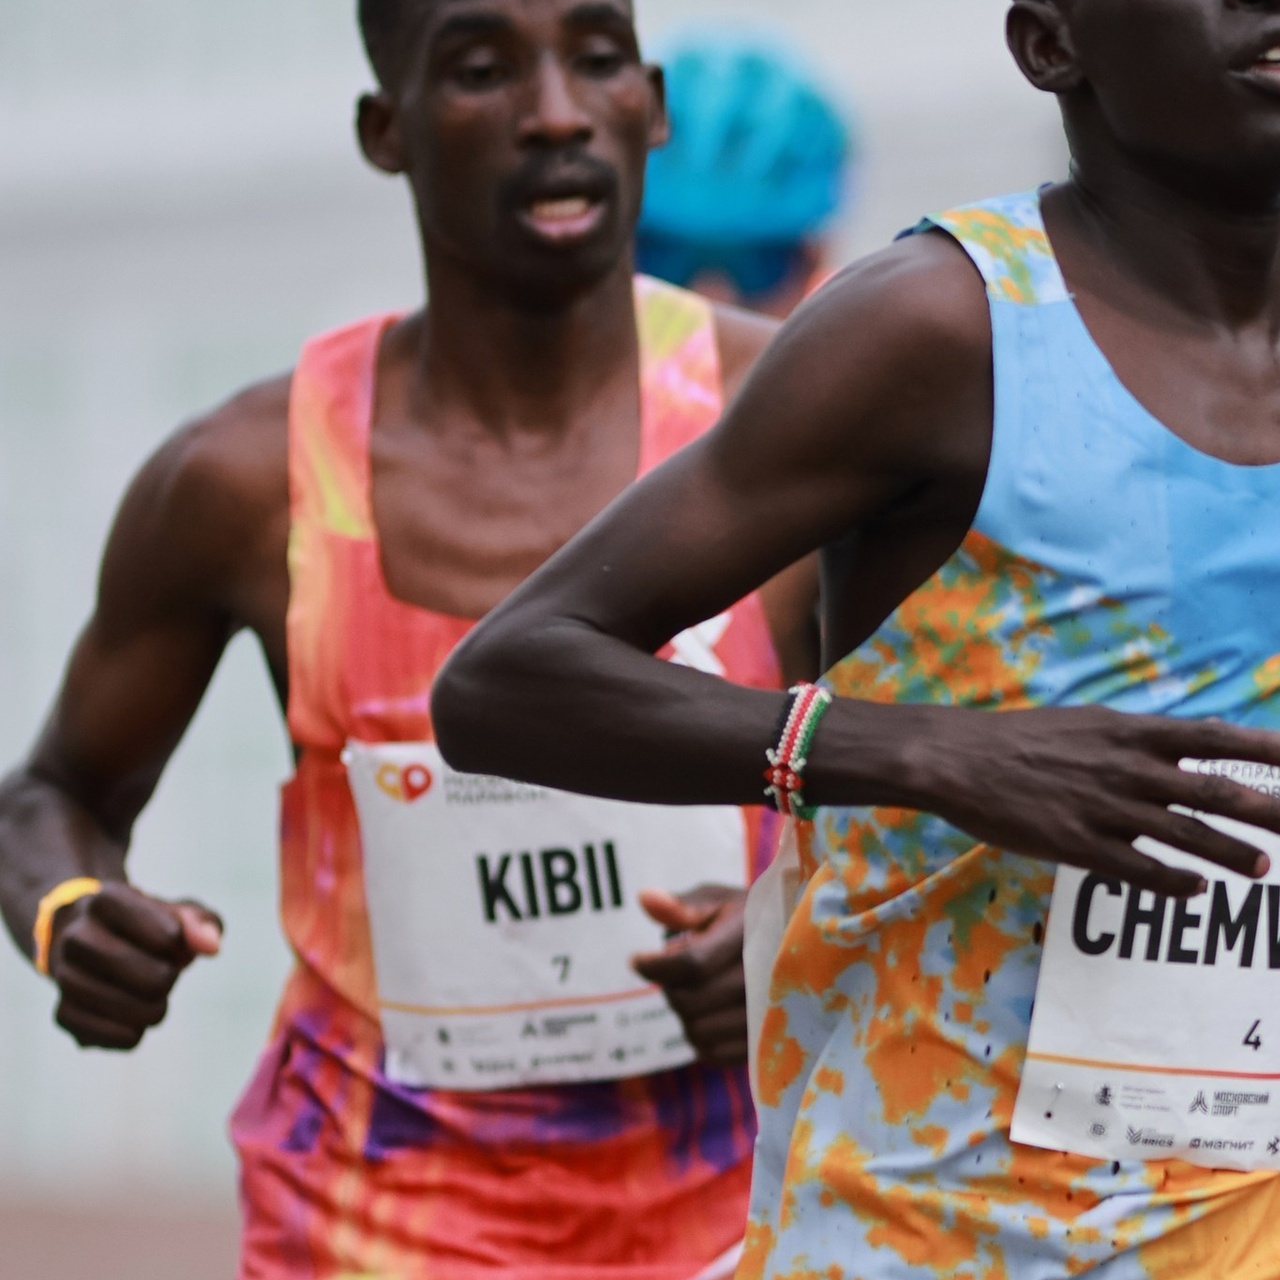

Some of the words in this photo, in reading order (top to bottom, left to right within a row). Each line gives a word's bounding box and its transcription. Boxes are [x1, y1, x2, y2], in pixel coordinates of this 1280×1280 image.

[476, 839, 625, 924] KIBII
[551, 954, 571, 984] 7
[1242, 1018, 1262, 1051] 4
